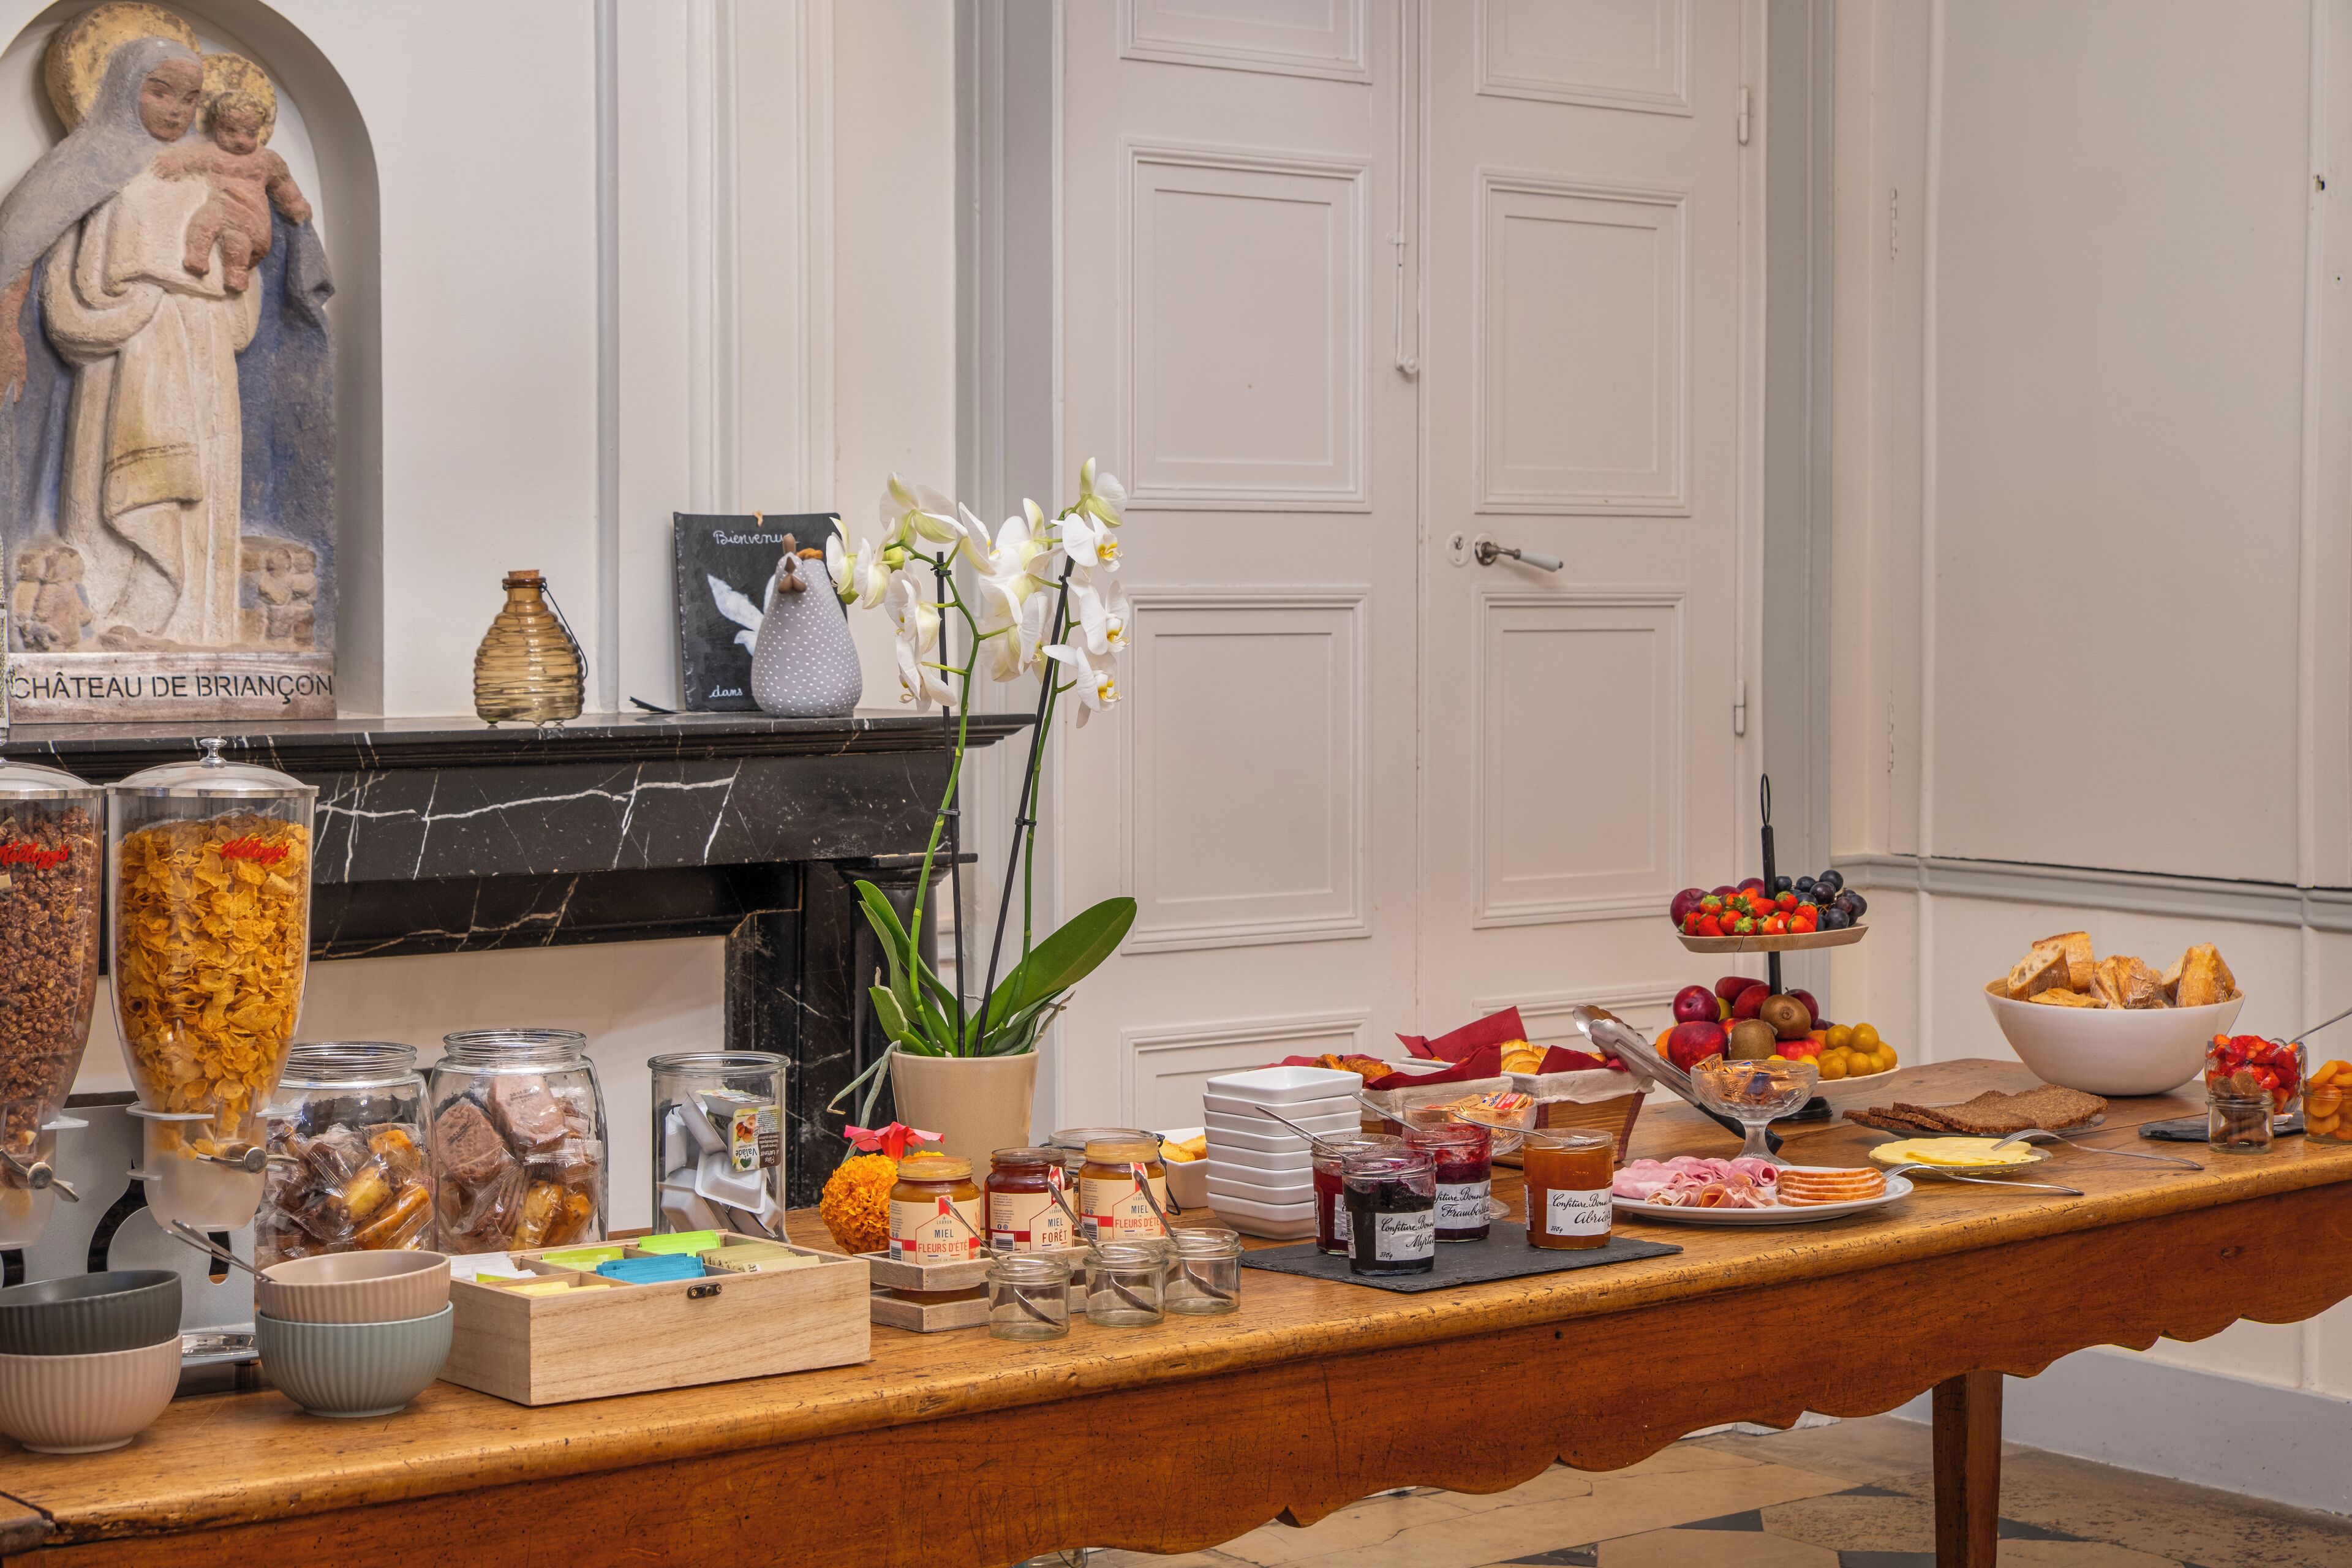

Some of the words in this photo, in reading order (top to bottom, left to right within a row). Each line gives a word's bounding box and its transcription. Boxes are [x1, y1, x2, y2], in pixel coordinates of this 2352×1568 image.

[713, 530, 799, 545] Bienvenu
[13, 672, 142, 699] CHÂTEAU
[152, 675, 188, 697] DE
[197, 674, 333, 704] BRIANÇON
[709, 685, 743, 698] dans
[221, 837, 290, 865] Kellogg's
[735, 1147, 758, 1157] Valade
[1434, 1191, 1460, 1204] fiture
[1553, 1193, 1588, 1211] Confiture
[1131, 1205, 1149, 1214] MIEL
[1047, 1217, 1063, 1227] MIEL
[1115, 1218, 1142, 1229] FLEURS
[1381, 1217, 1417, 1235] Confiture
[934, 1229, 954, 1238] MIEL
[1042, 1229, 1068, 1243] FORÊT
[918, 1243, 947, 1253] FLEURS
[949, 1239, 968, 1252] D'ÉTÉ
